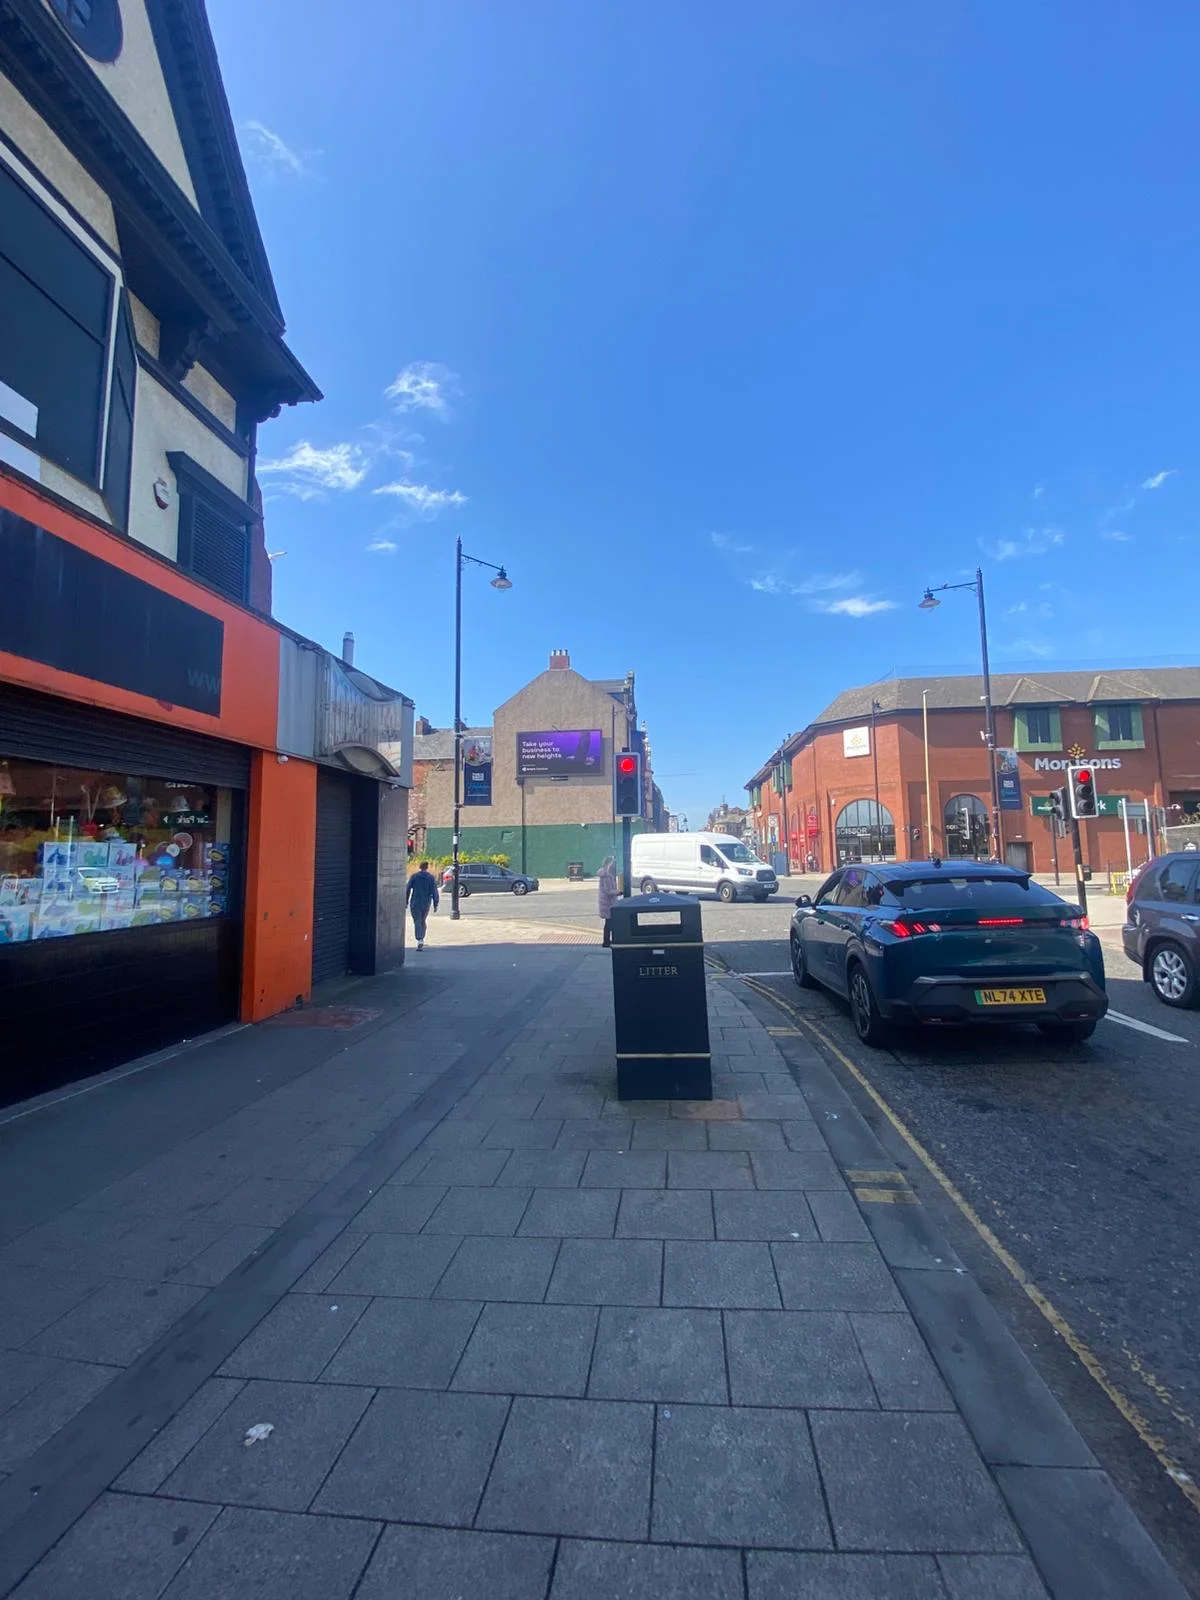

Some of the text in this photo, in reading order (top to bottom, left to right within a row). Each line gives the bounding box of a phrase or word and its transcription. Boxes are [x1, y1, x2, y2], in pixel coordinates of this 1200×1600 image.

[1034, 758, 1121, 770] Morisons
[640, 966, 678, 976] LITTER
[983, 989, 1044, 1002] NL74 XTE
